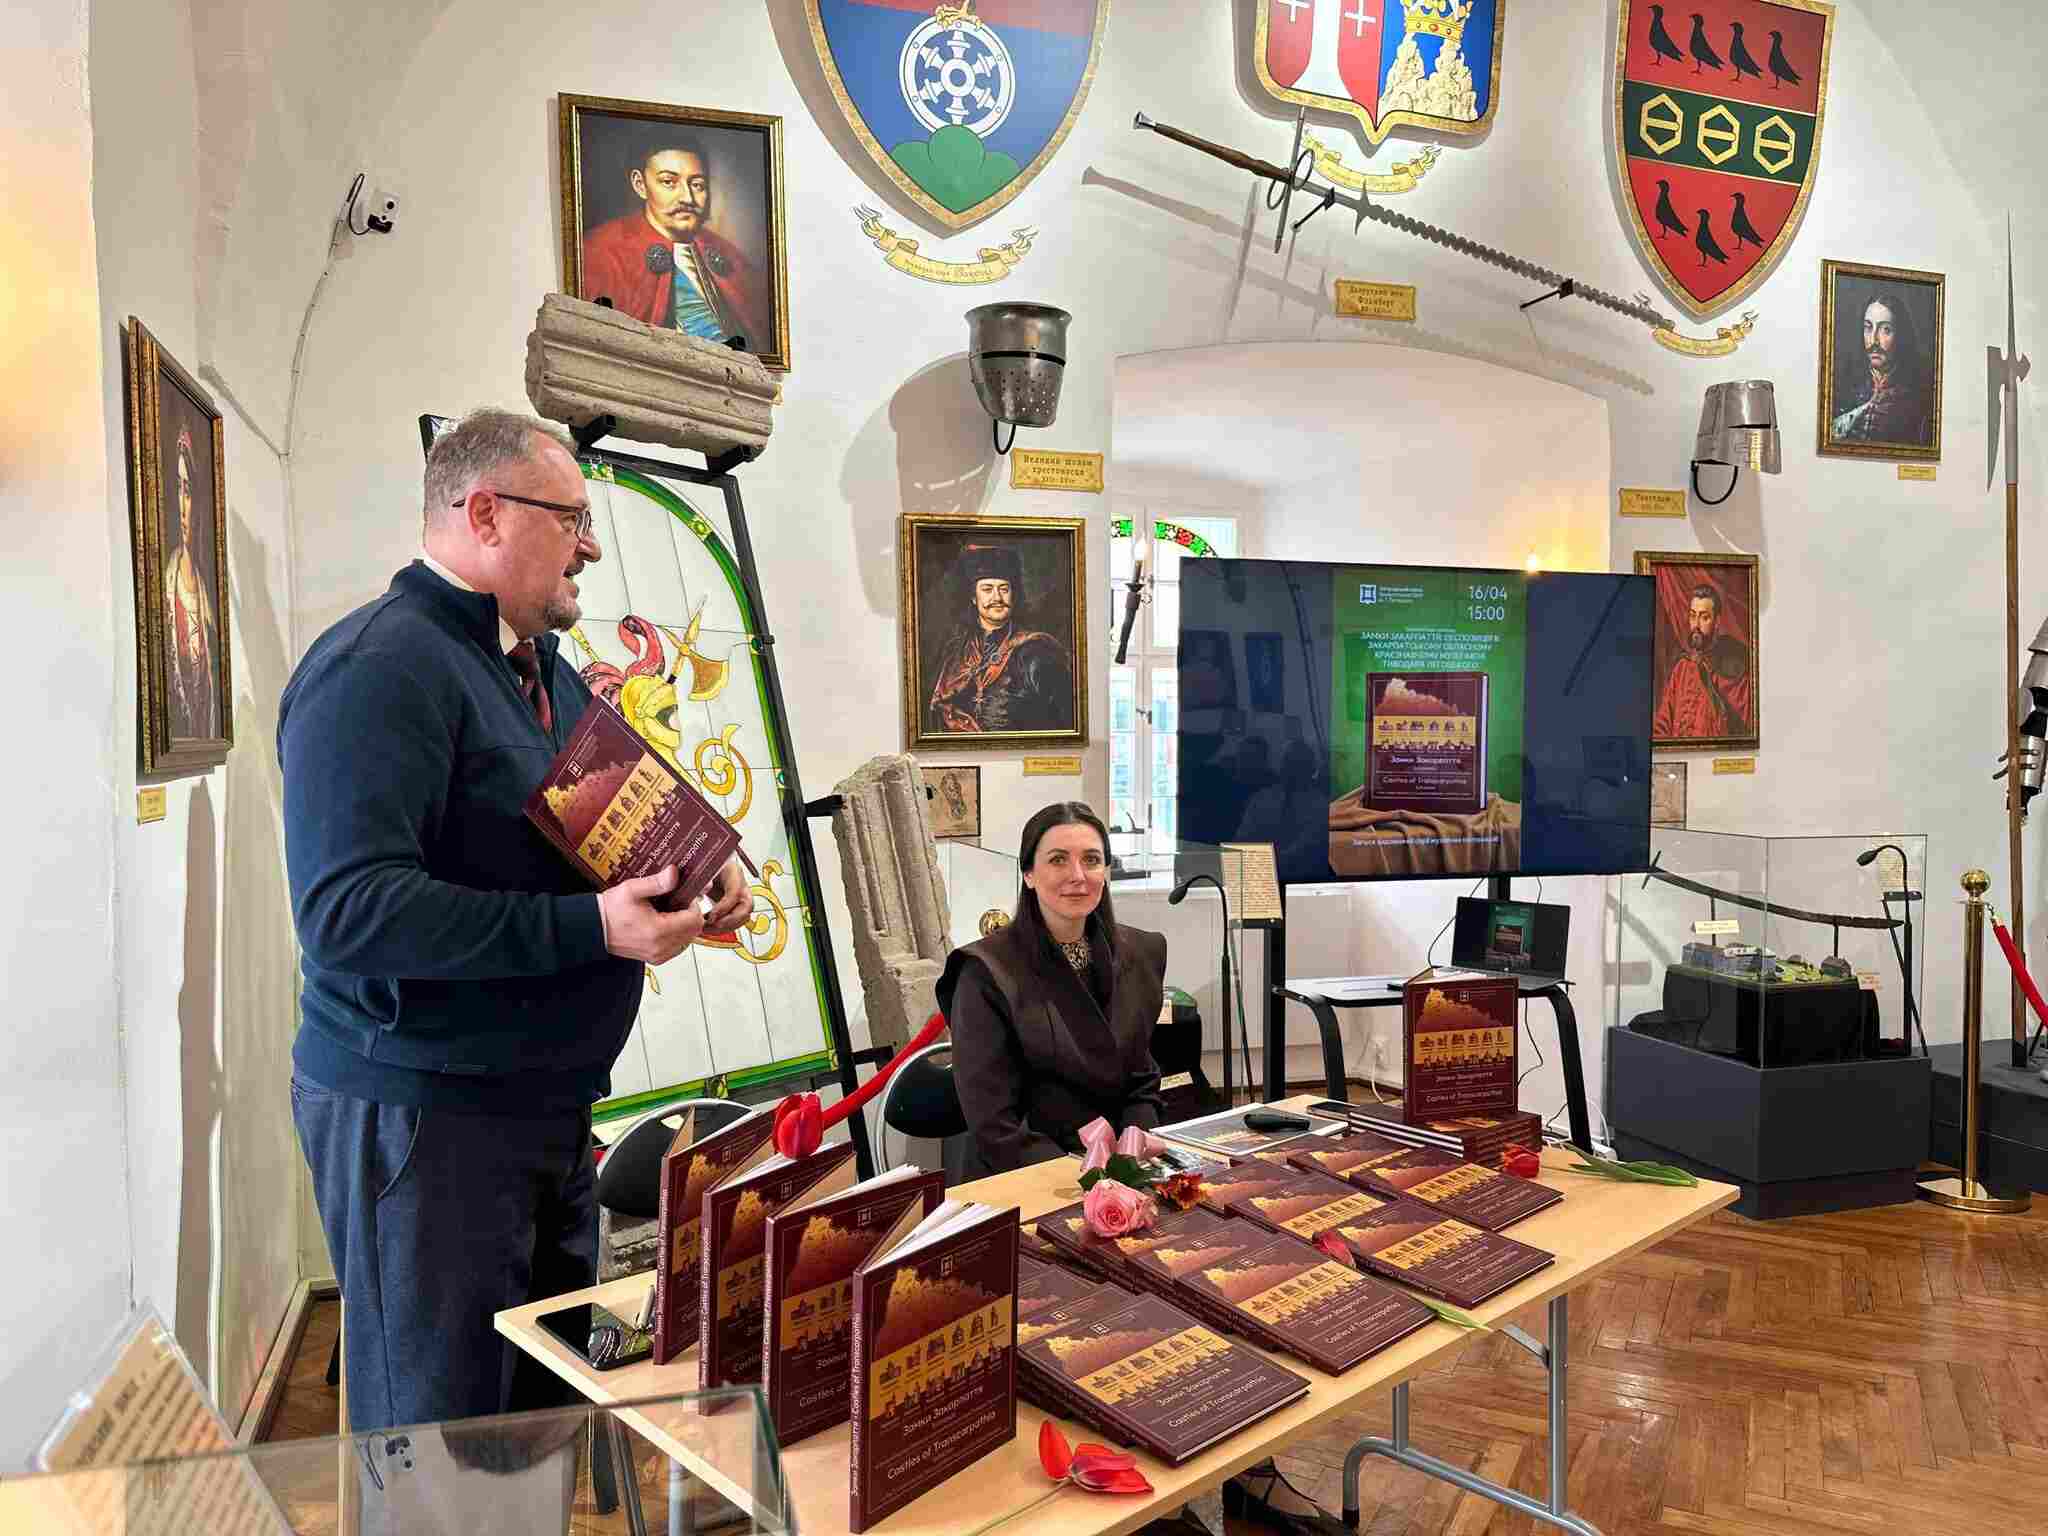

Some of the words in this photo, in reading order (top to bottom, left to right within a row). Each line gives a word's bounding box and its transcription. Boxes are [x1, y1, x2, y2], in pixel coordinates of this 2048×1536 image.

[1024, 454, 1060, 465] Великий
[1468, 585, 1508, 601] 16/04
[1467, 606, 1505, 621] 15:00
[799, 1387, 835, 1409] Castles
[903, 1414, 932, 1437] Замки
[932, 1386, 984, 1420] Закарпаття
[1168, 1409, 1201, 1428] Castles
[887, 1455, 921, 1480] Castles
[921, 1445, 934, 1460] of
[932, 1409, 997, 1449] Transcarpathia
